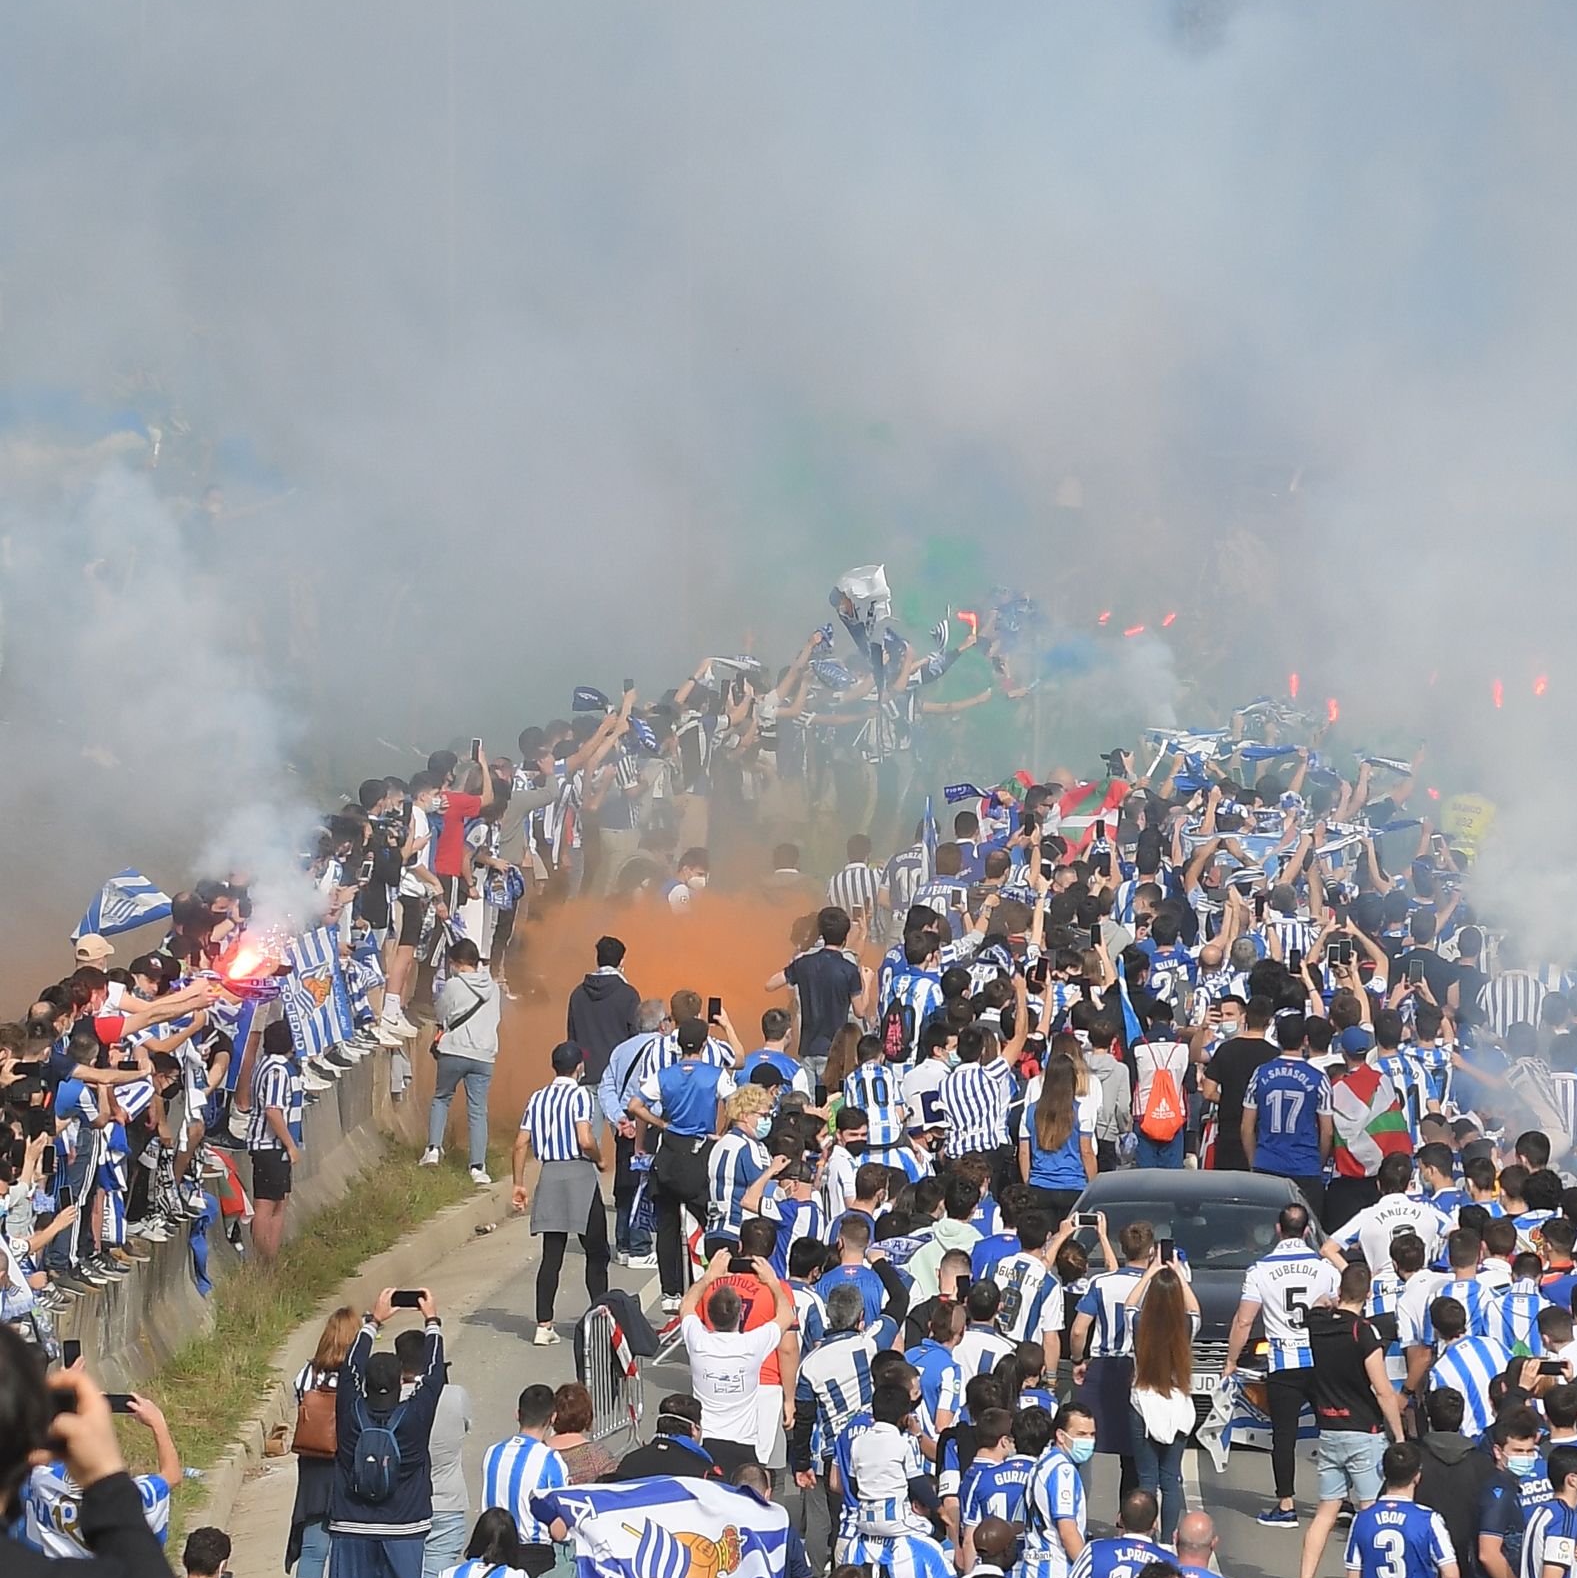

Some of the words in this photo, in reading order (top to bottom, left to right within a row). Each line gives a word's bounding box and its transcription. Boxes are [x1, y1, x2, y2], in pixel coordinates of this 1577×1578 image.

[280, 984, 306, 1052] SOCIEDAD
[1265, 1089, 1305, 1134] 17
[1375, 1208, 1422, 1224] JANUZAJ
[1269, 1264, 1319, 1281] ZUBELDIA
[1283, 1286, 1309, 1329] 5
[1375, 1513, 1407, 1526] IBON
